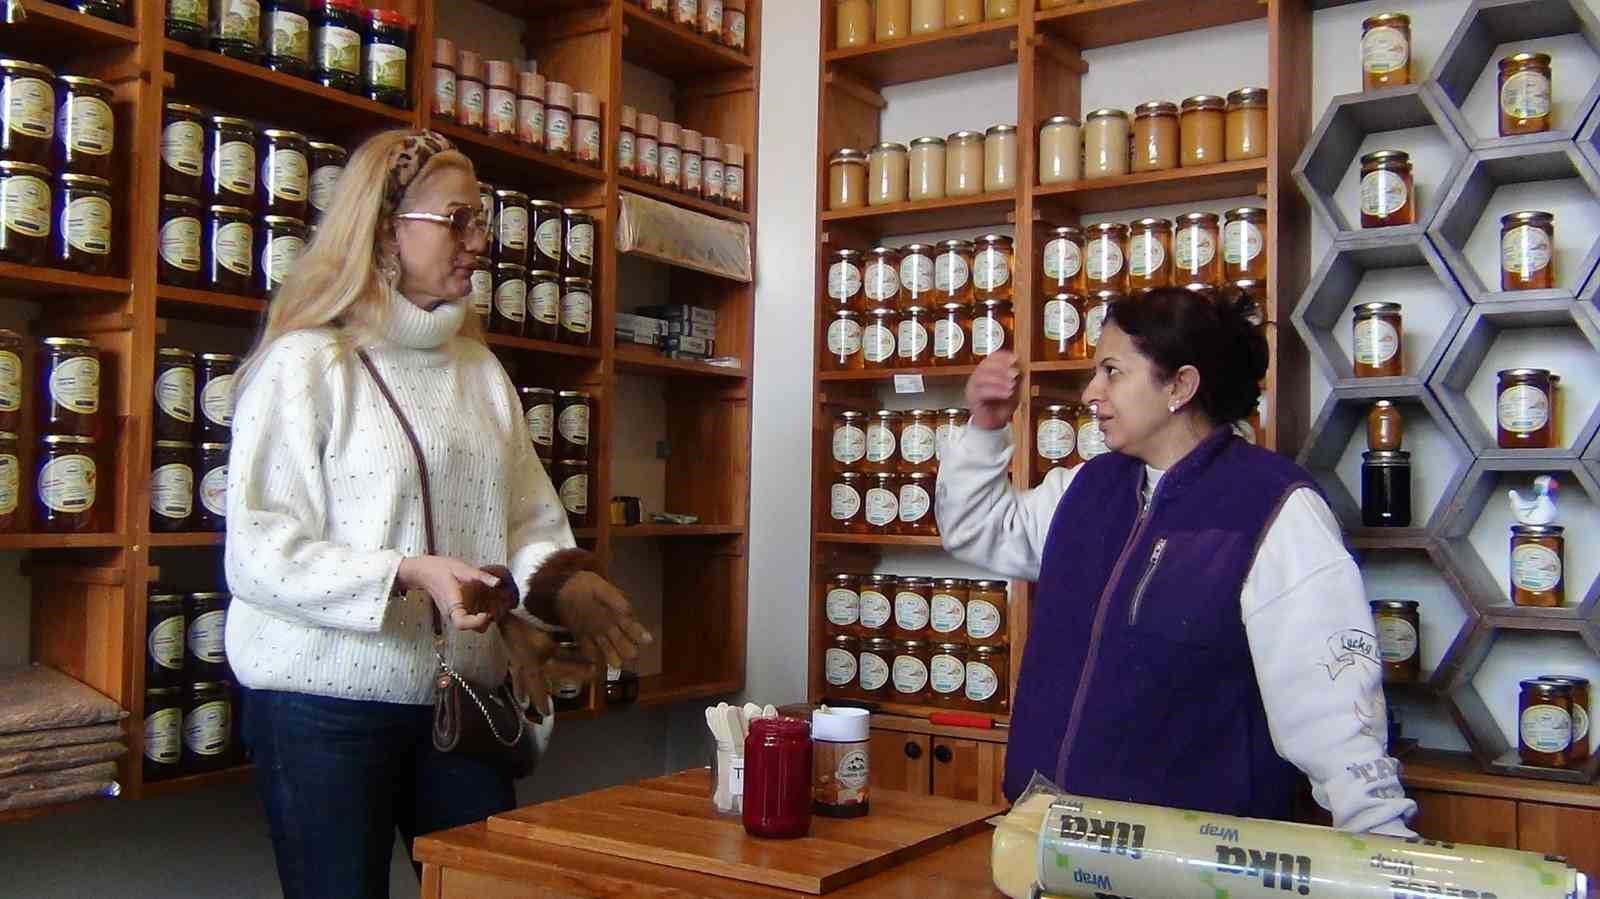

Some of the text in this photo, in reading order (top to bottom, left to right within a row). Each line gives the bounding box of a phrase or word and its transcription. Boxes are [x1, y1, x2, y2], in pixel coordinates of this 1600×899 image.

[1340, 634, 1373, 656] Lucky
[1060, 814, 1147, 860] ilka
[1199, 823, 1240, 842] Wrap
[1215, 844, 1312, 896] ilka
[1370, 853, 1415, 876] Wrap
[1073, 867, 1113, 891] Wrap
